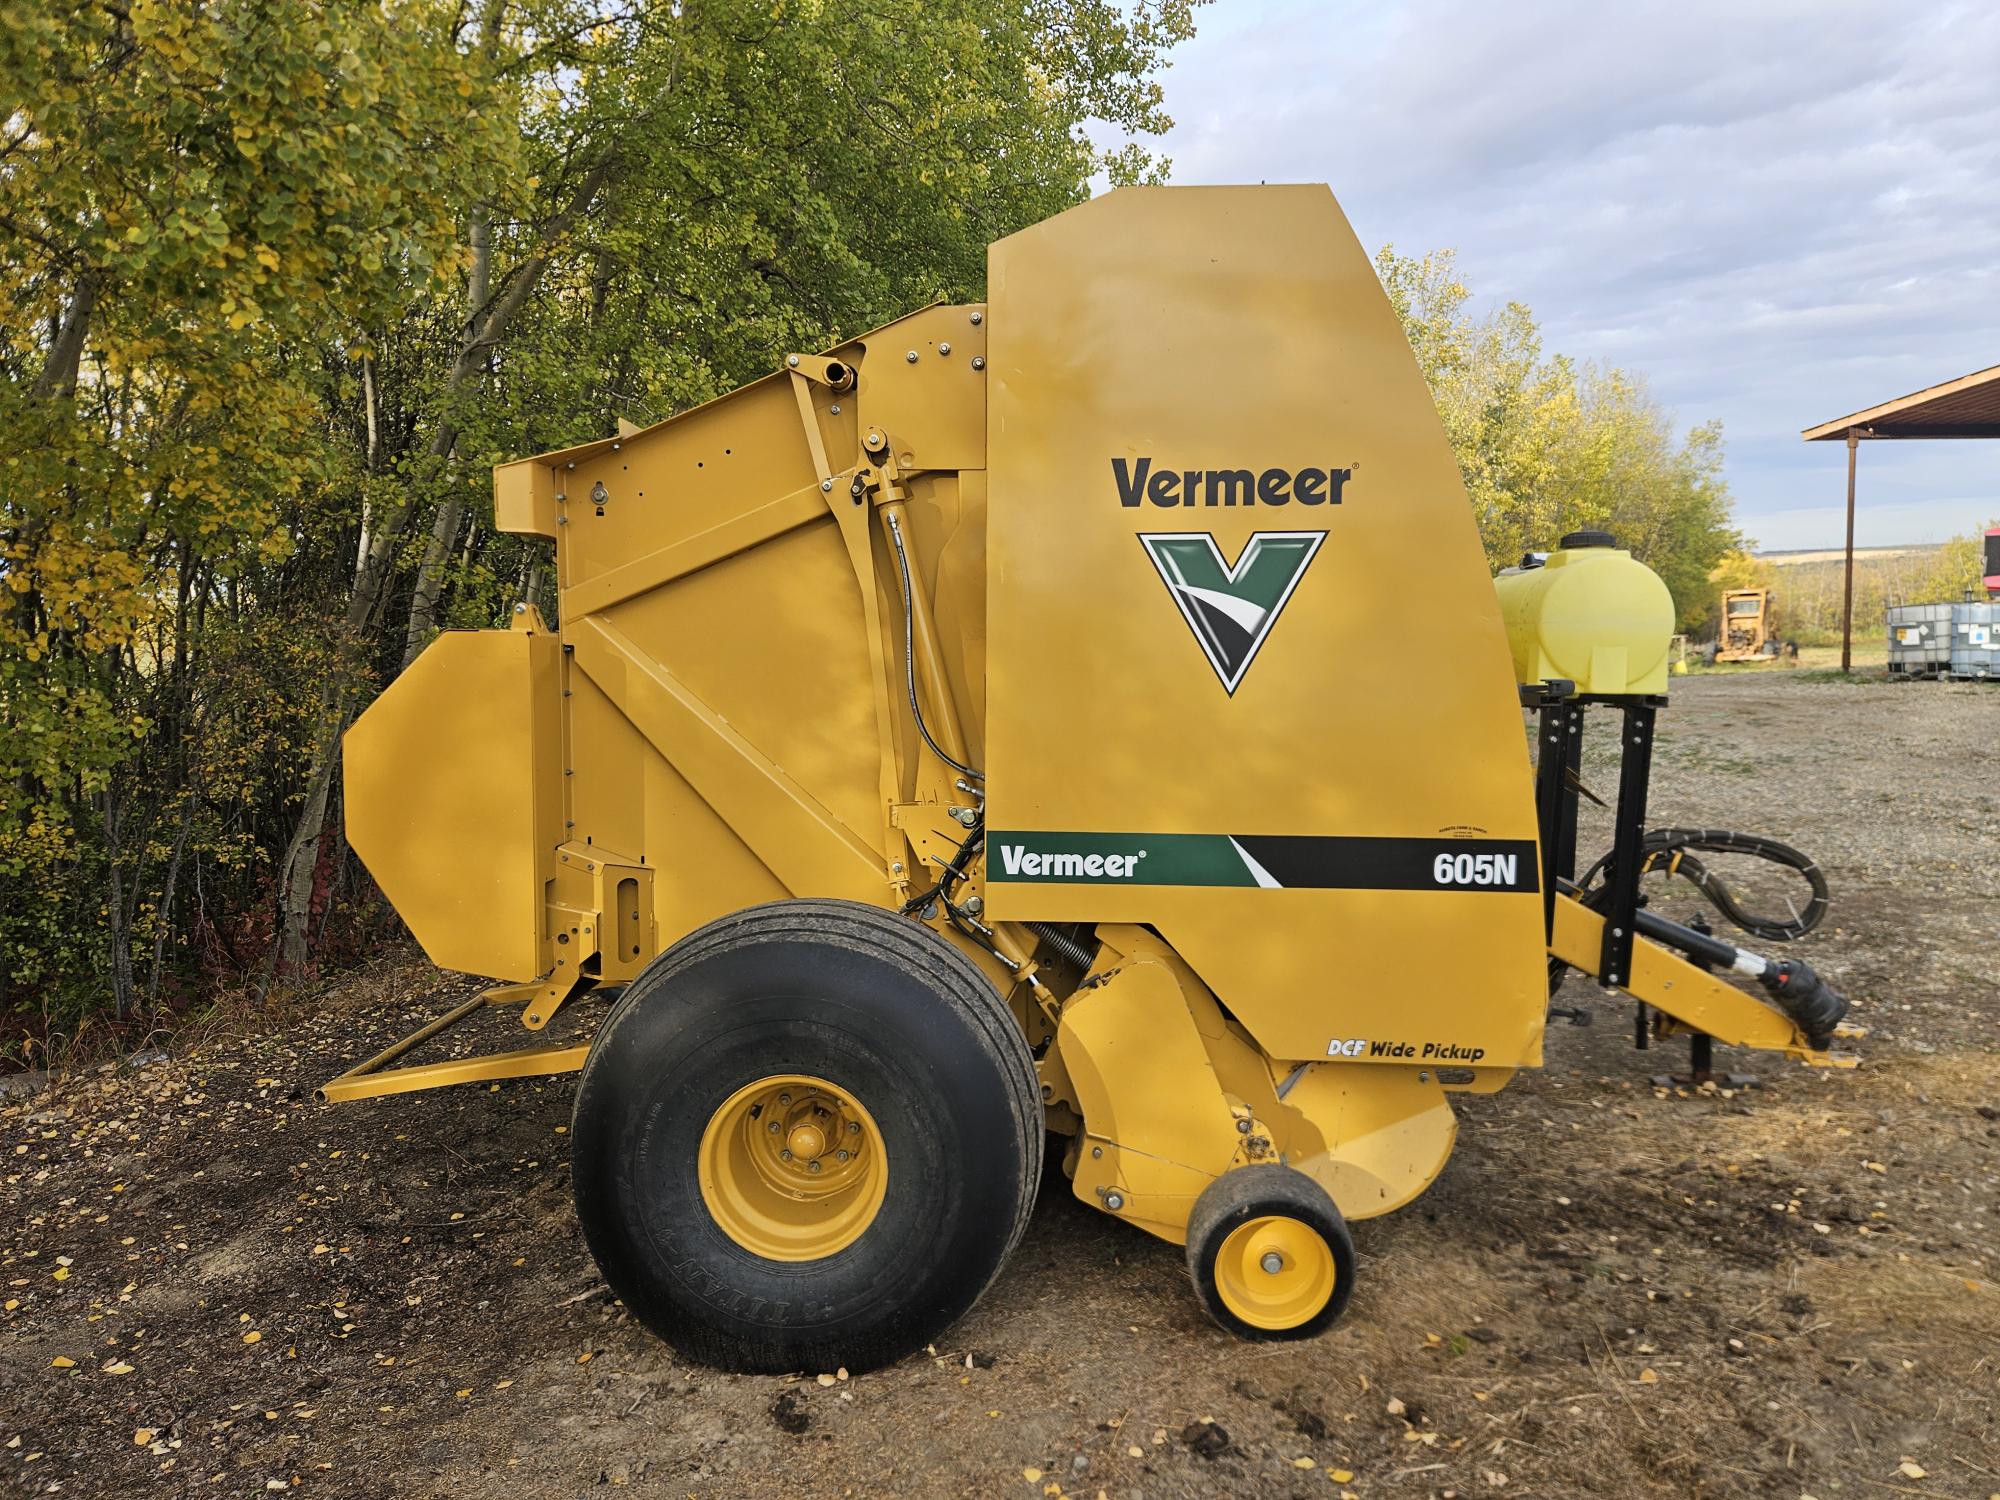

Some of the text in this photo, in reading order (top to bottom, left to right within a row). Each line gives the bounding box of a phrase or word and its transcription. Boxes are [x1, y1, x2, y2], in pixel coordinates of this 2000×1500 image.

[1111, 457, 1351, 508] Vermeer
[1000, 845, 1139, 877] Vermeer
[1433, 853, 1518, 885] 605N
[1326, 1039, 1485, 1063] DCF Wide Pickup
